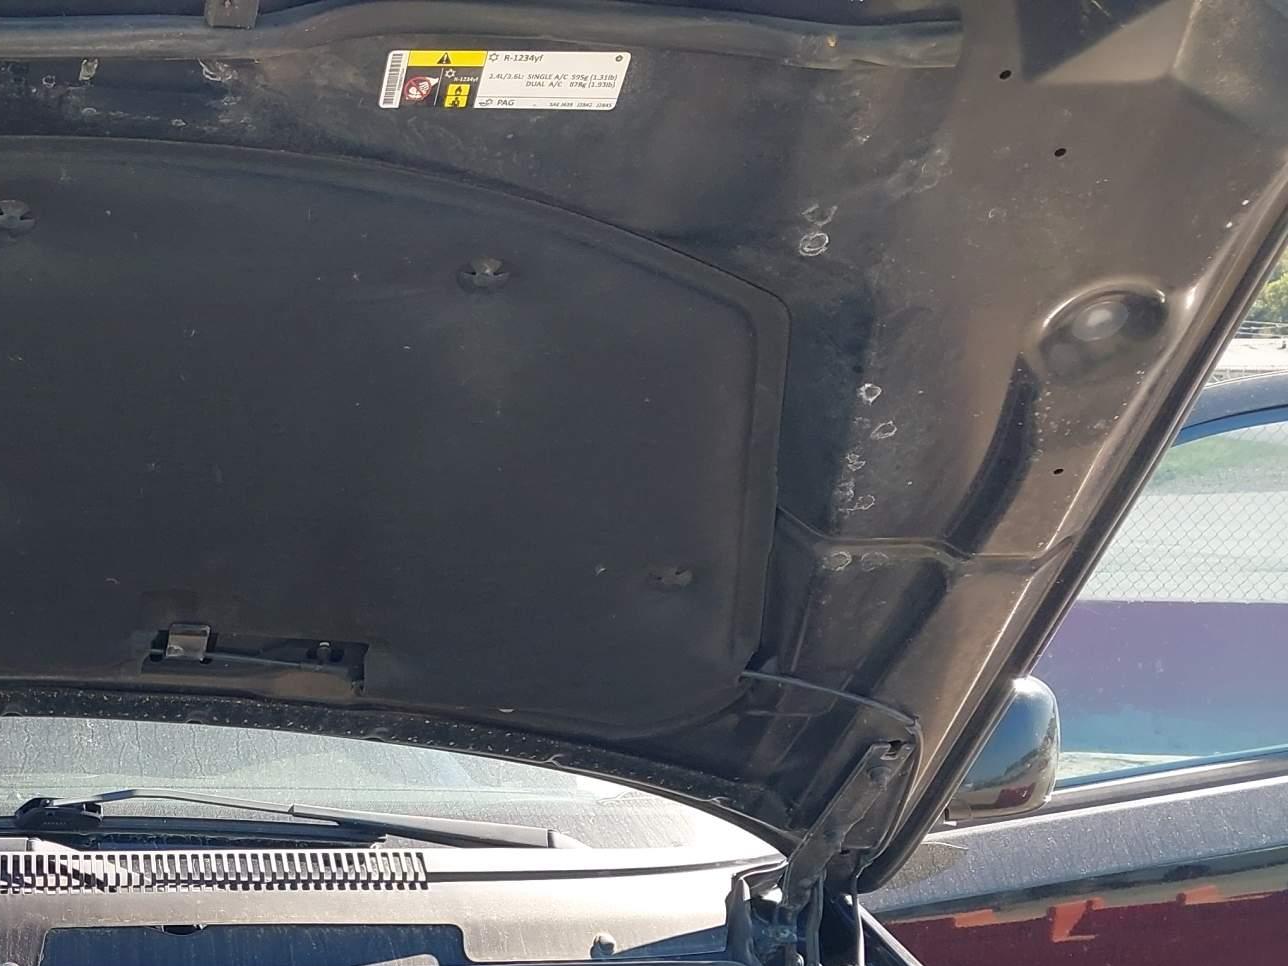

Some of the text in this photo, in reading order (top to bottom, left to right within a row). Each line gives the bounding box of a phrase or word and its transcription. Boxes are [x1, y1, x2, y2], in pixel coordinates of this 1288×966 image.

[503, 54, 544, 63] R-1234yf
[553, 73, 568, 81] A/C
[548, 81, 562, 89] A/C
[497, 99, 515, 107] PAG
